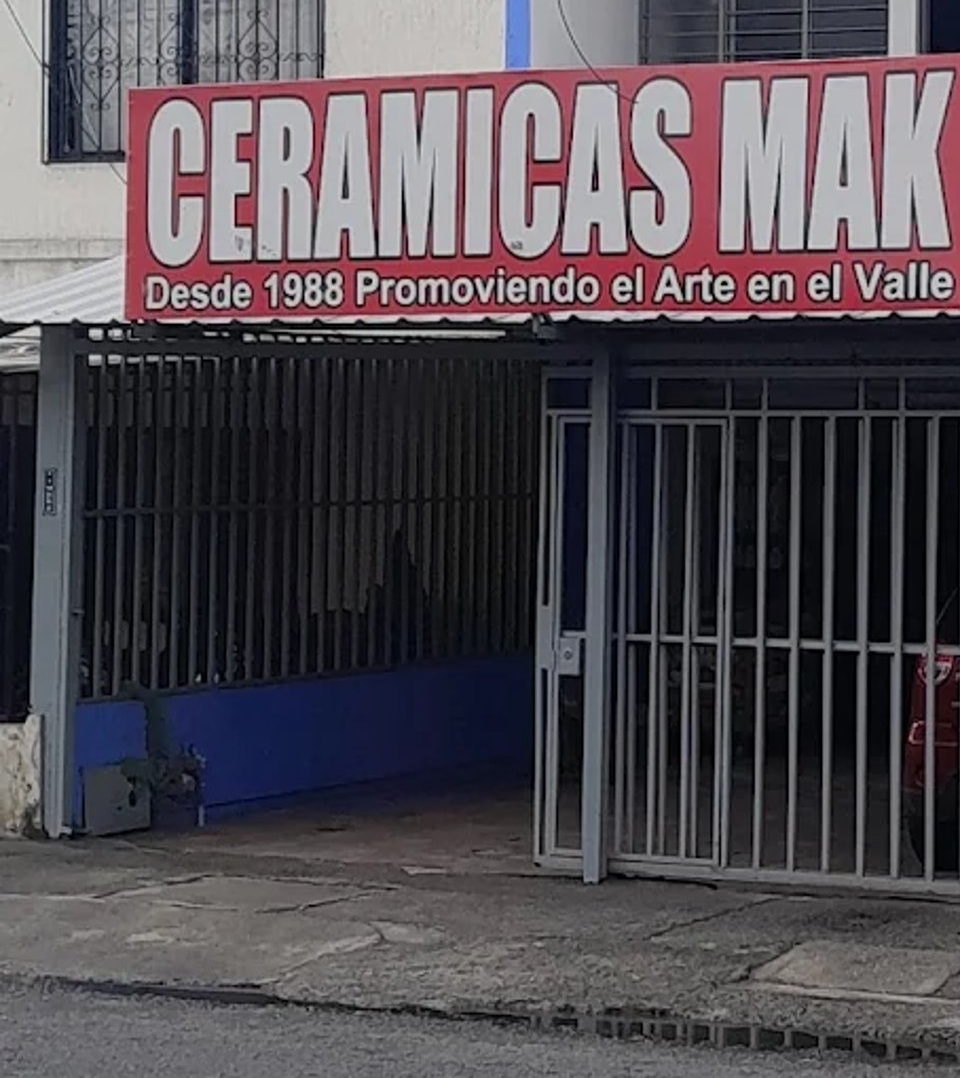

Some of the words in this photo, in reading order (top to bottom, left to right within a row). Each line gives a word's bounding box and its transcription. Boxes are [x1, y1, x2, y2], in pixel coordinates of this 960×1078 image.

[146, 75, 693, 268] CERAMICAS
[717, 69, 957, 253] MAK
[144, 274, 253, 311] Desde
[263, 270, 345, 309] 1988
[355, 264, 600, 309] Promoviendo
[610, 264, 645, 305] el
[653, 264, 736, 304] Arte
[746, 270, 795, 302] en
[806, 261, 842, 302] el
[853, 260, 956, 302] Valle
